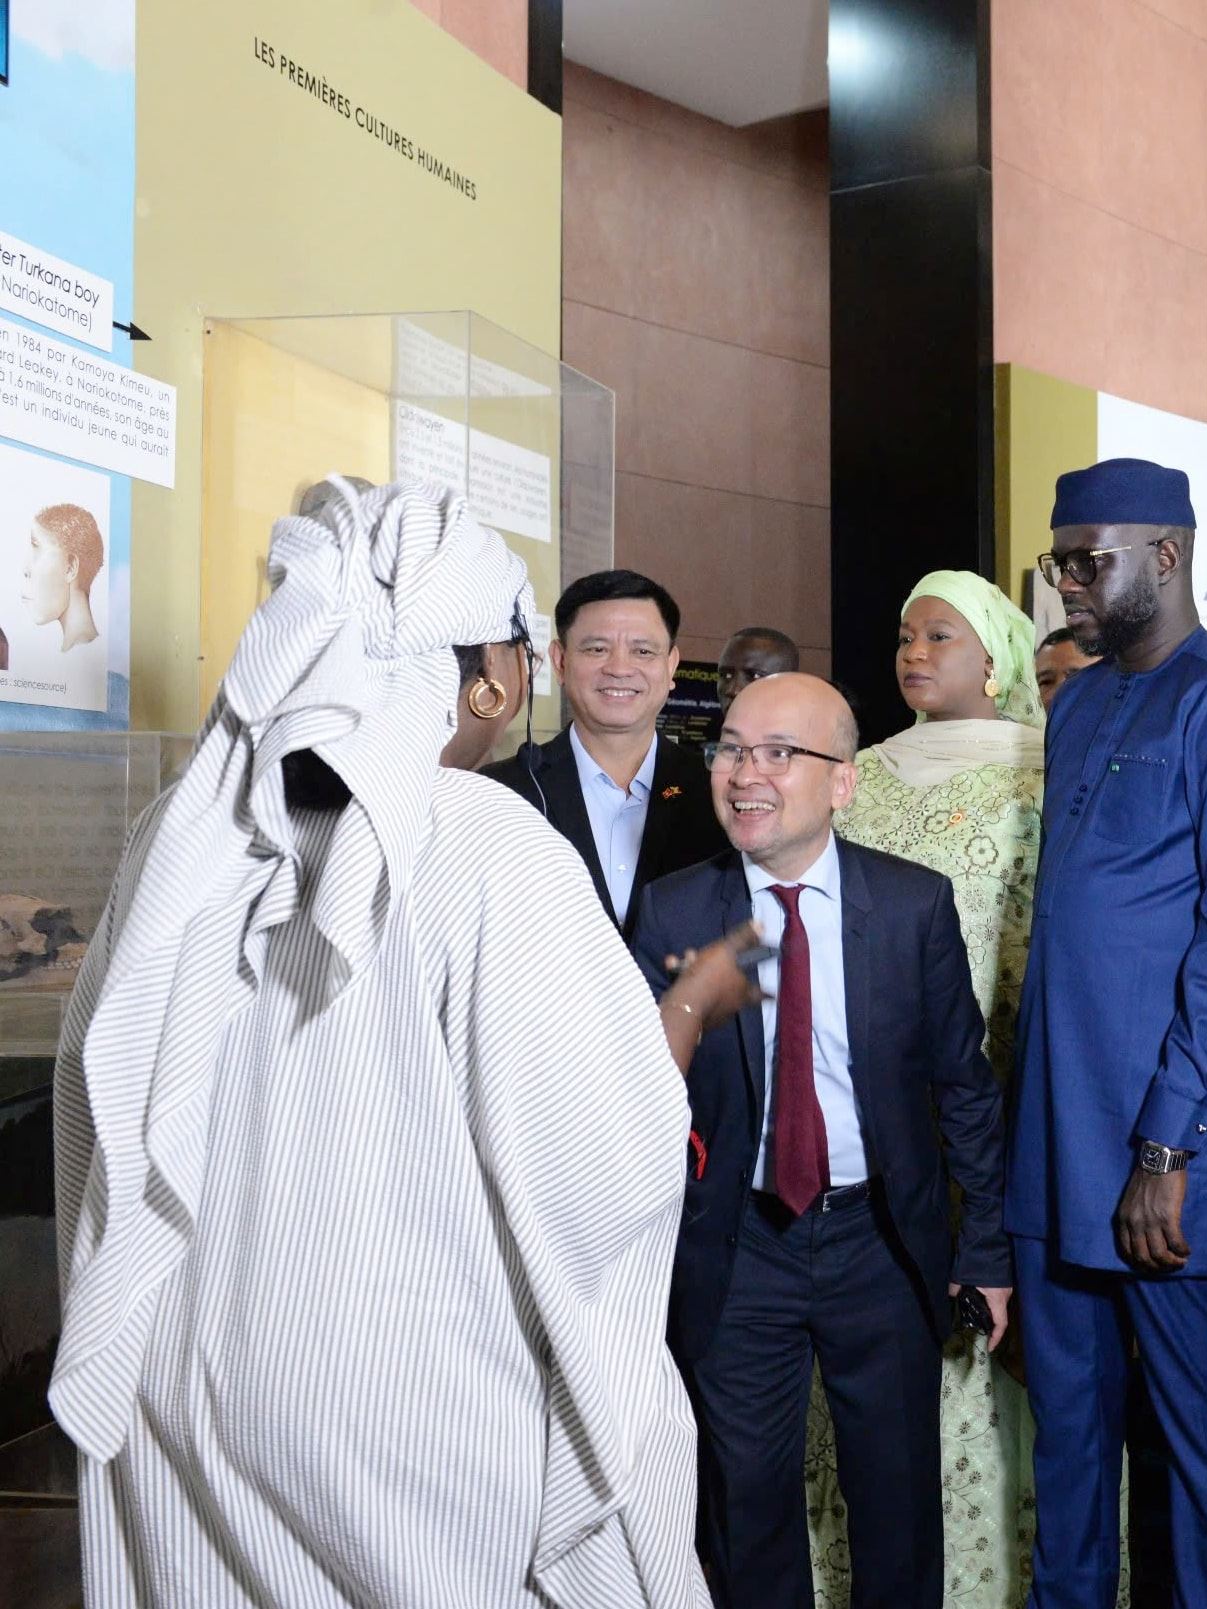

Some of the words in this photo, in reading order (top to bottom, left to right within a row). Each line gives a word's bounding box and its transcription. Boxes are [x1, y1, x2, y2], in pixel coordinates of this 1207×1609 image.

[254, 36, 275, 69] LES
[280, 54, 351, 119] PREMIÈRES
[355, 107, 414, 160] CULTURES
[417, 148, 477, 201] HUMAINES
[19, 254, 71, 293] Turkana
[75, 280, 100, 308] boy
[17, 332, 41, 354] 1984
[48, 348, 66, 363] par
[159, 390, 170, 403] un
[24, 400, 37, 414] un
[42, 403, 84, 429] individu
[88, 418, 117, 440] jeune
[122, 434, 137, 447] qui
[141, 441, 169, 456] aurait
[26, 380, 61, 402] millions
[115, 412, 132, 426] son
[135, 417, 154, 435] âge
[157, 427, 169, 439] au
[150, 406, 169, 421] près
